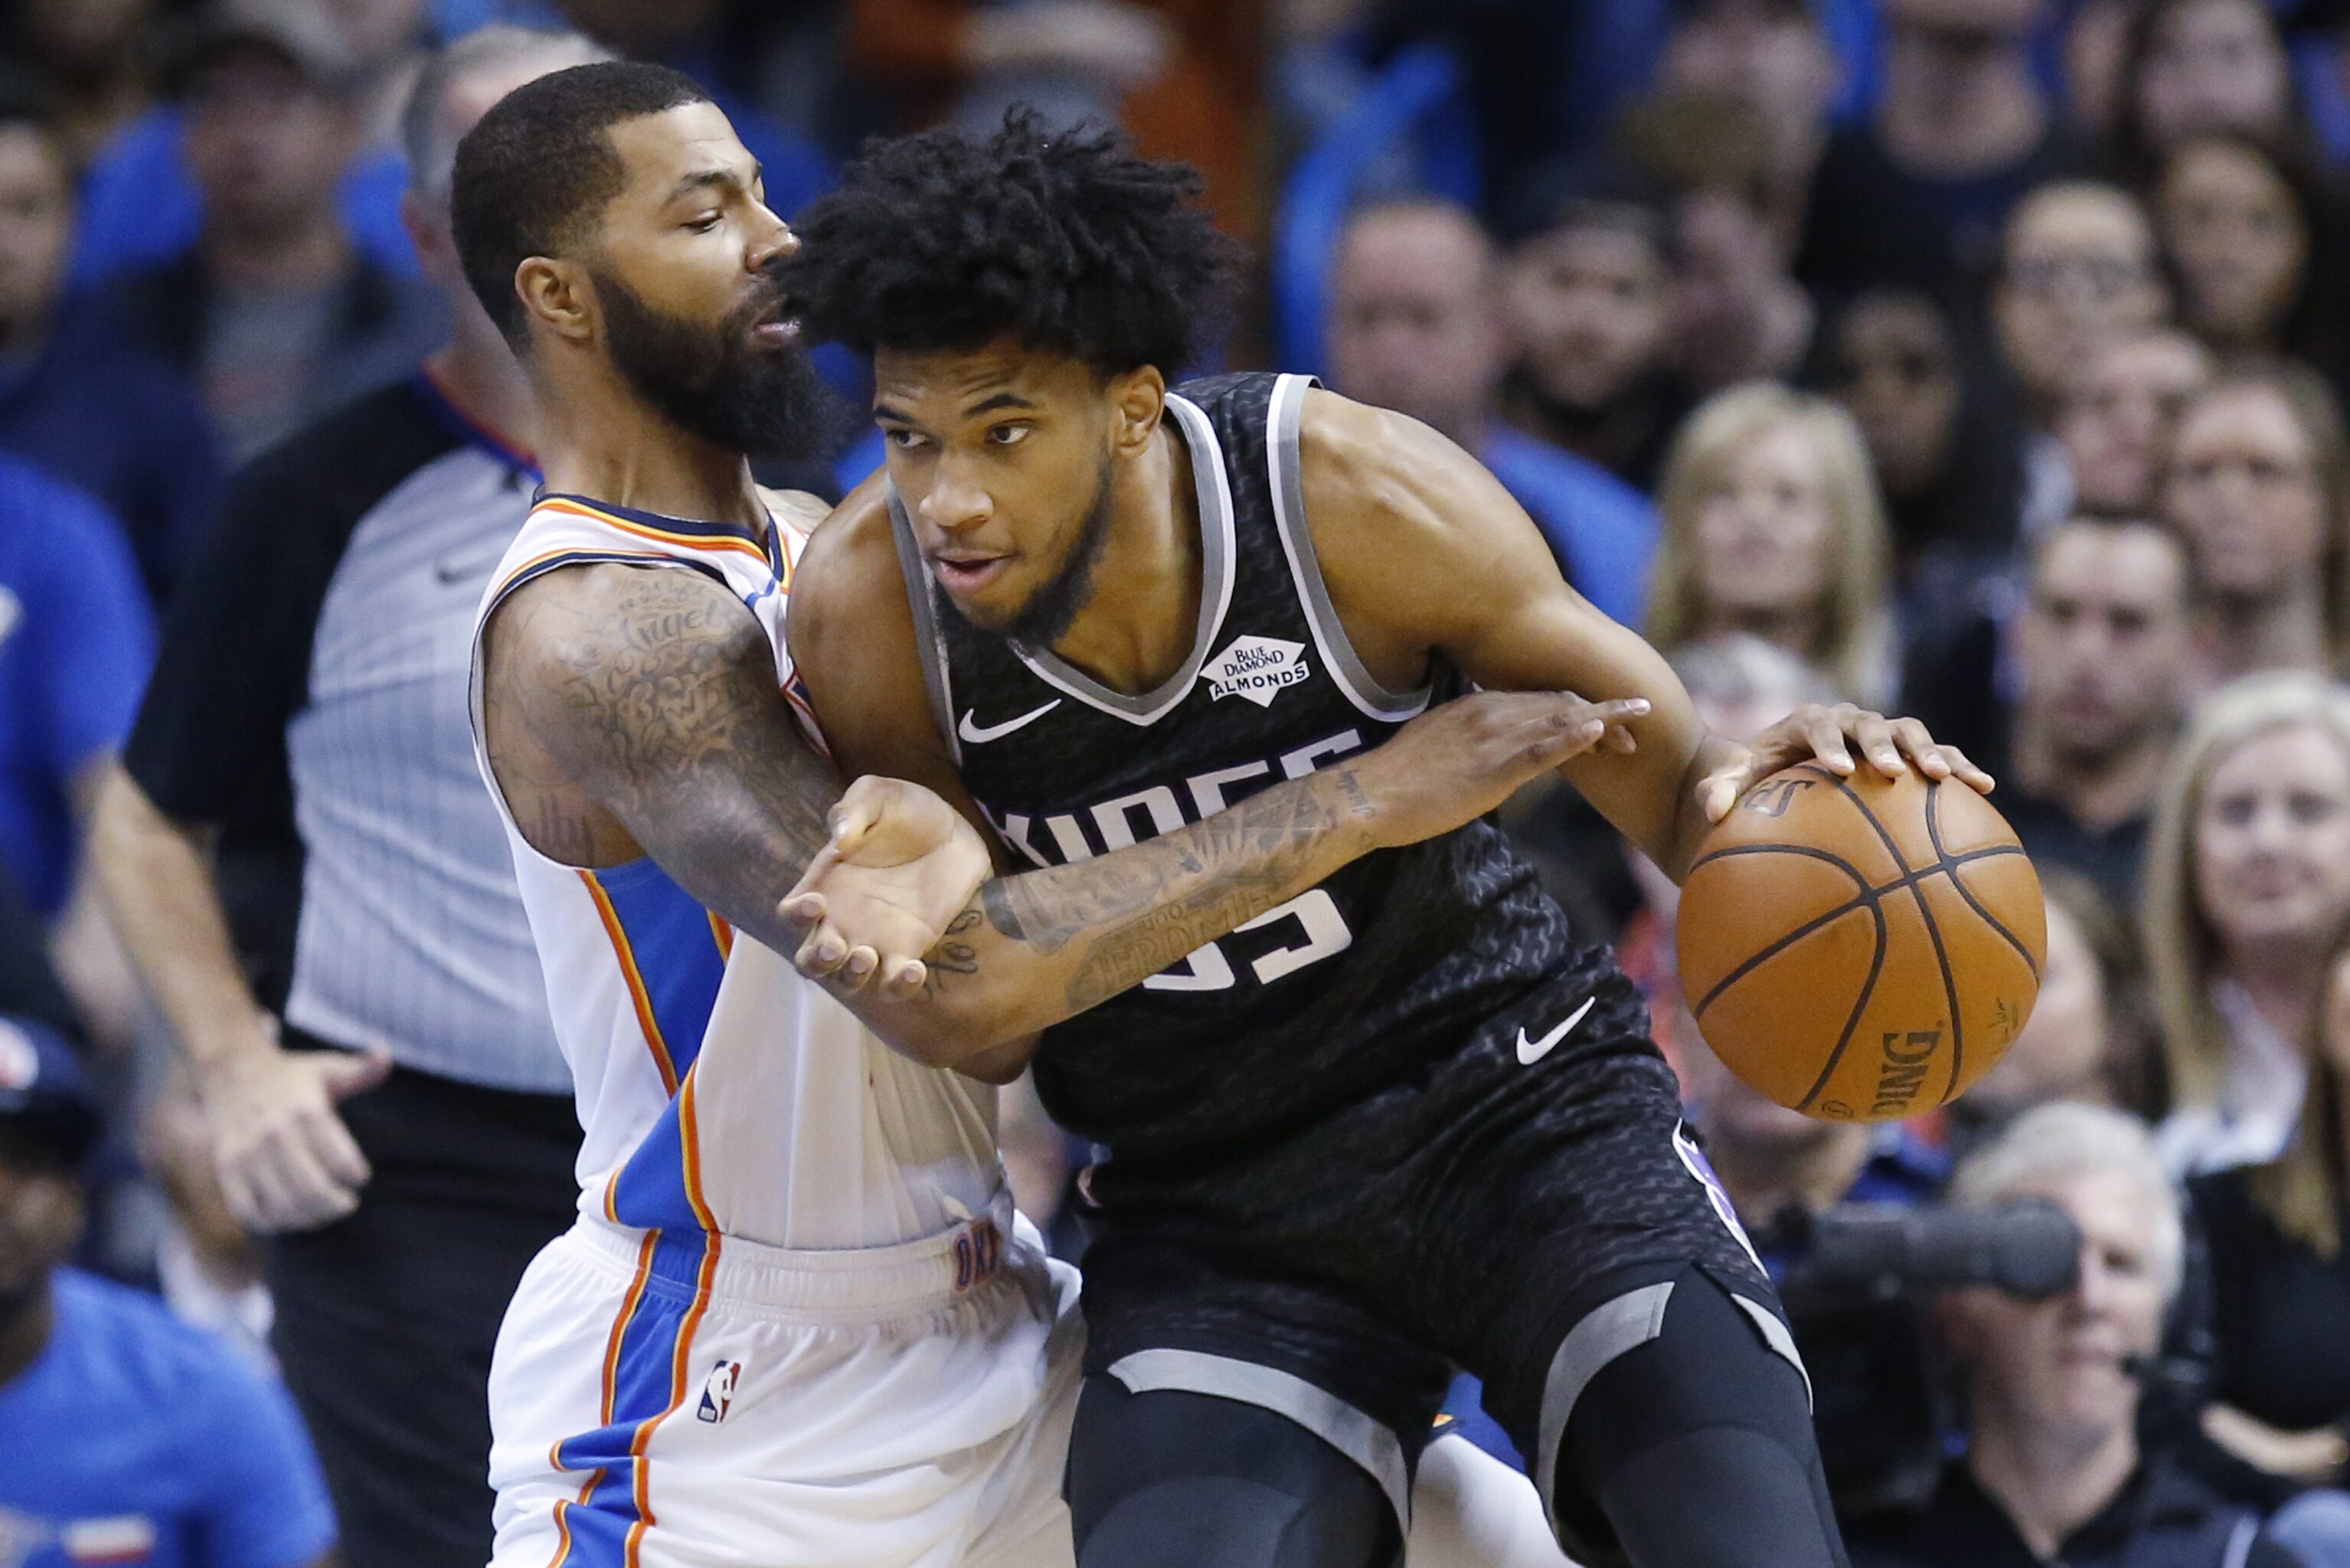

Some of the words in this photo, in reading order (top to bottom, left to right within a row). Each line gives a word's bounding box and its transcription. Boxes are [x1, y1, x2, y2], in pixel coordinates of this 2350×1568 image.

[1224, 650, 1284, 677] DIAMOND
[1234, 645, 1267, 664] BLUE
[1214, 665, 1306, 697] ALMONDS
